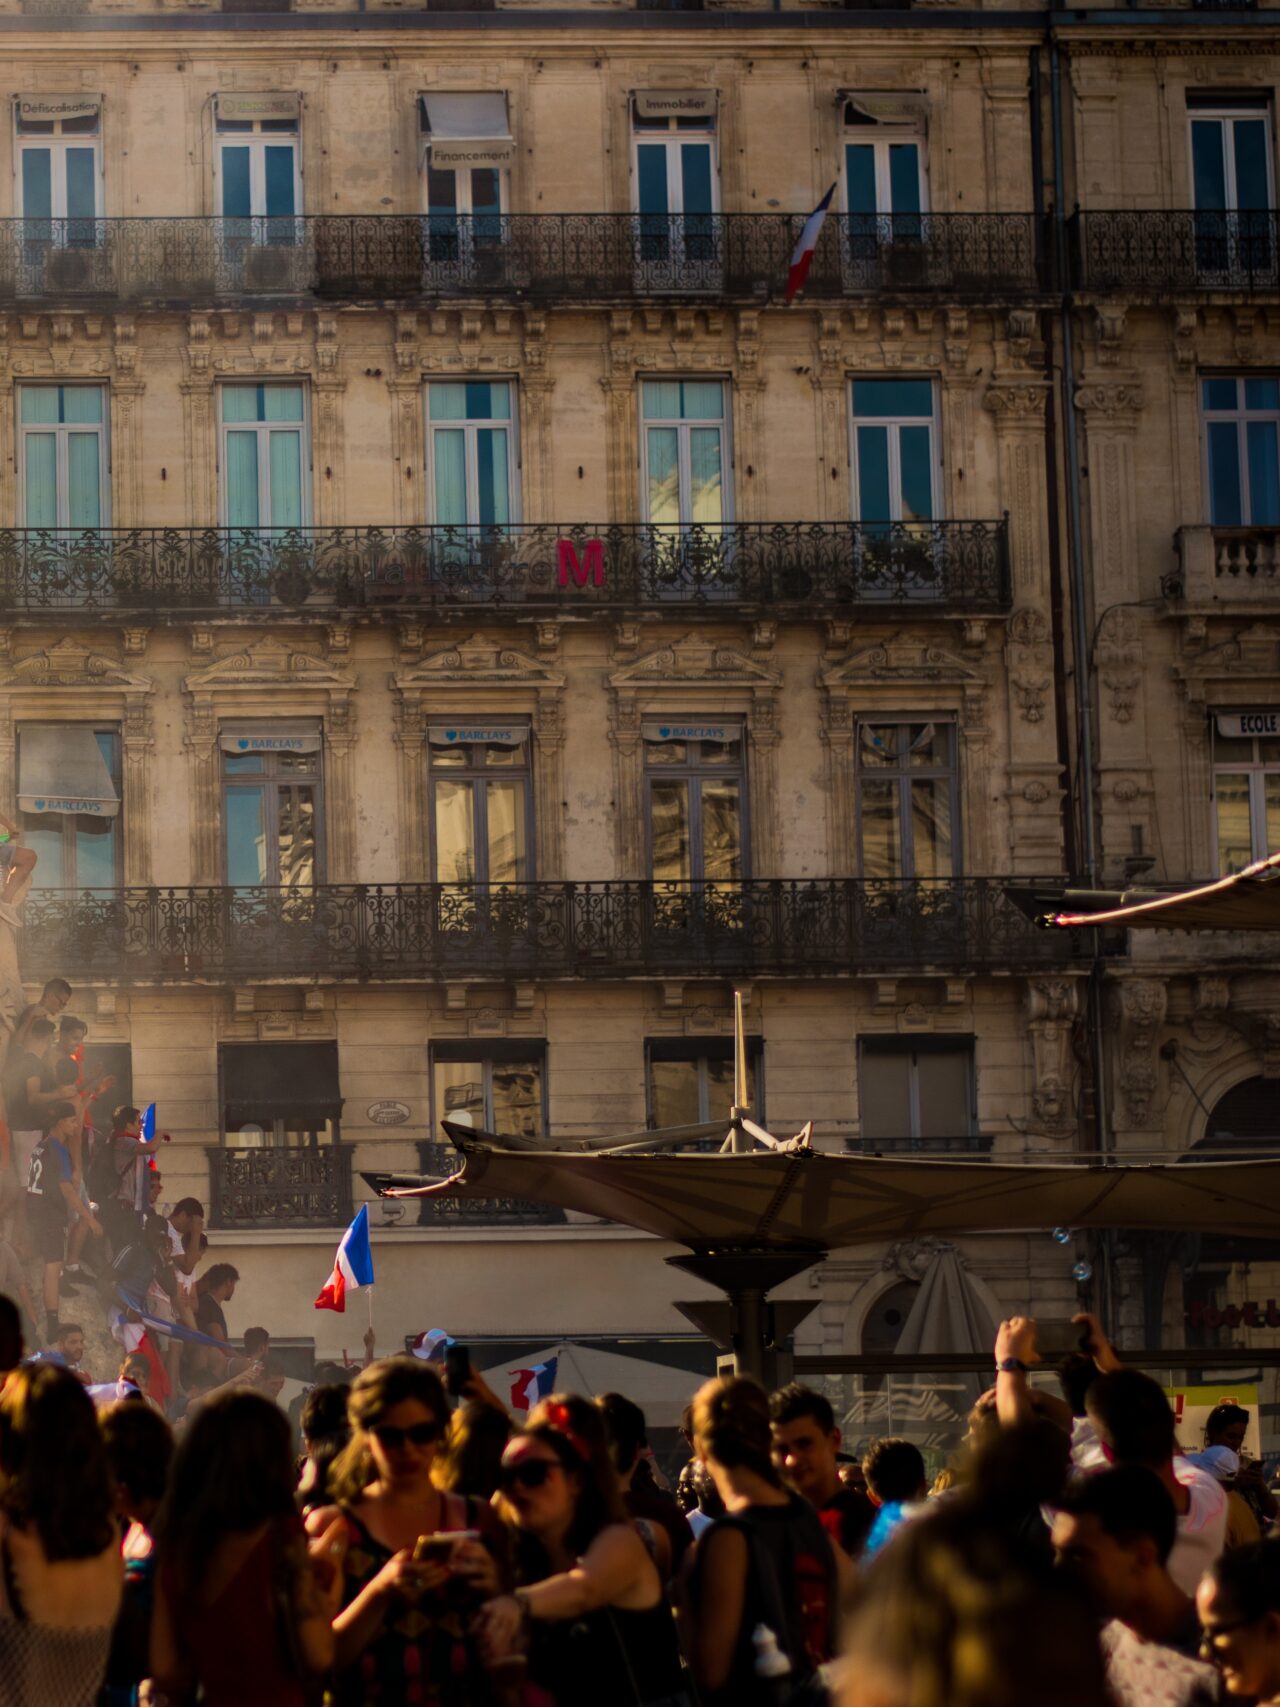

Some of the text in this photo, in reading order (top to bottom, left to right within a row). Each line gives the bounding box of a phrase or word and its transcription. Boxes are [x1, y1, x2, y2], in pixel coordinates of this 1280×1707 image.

[646, 99, 705, 109] Immobilier
[434, 150, 510, 161] Financement
[1240, 715, 1277, 733] ECOLE
[459, 731, 512, 740] BARCLAYS
[672, 727, 725, 737] BARCLAYS
[251, 739, 304, 749] BARCLAYS
[47, 800, 101, 812] BARCLAYS
